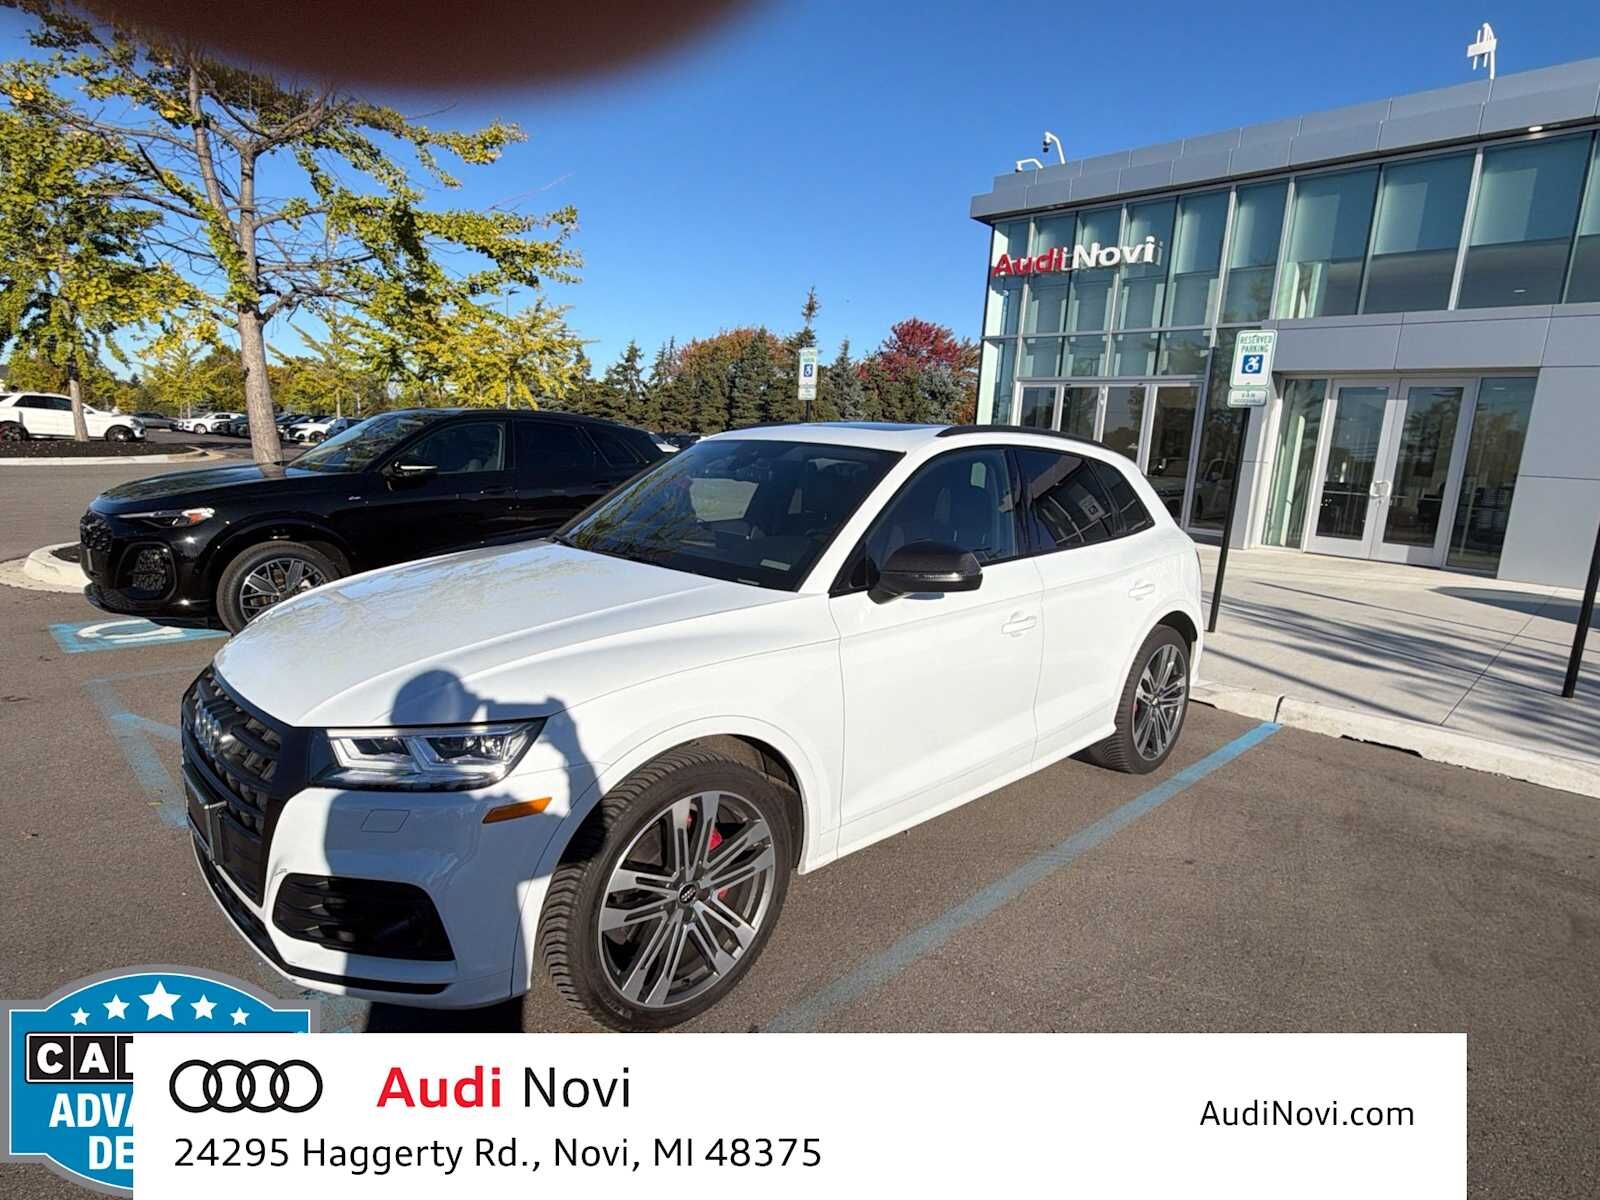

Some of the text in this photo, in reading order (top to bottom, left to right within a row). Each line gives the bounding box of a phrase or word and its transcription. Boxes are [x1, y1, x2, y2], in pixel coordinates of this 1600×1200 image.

[992, 235, 1156, 276] Audi Novi
[1240, 335, 1273, 344] RESERVED
